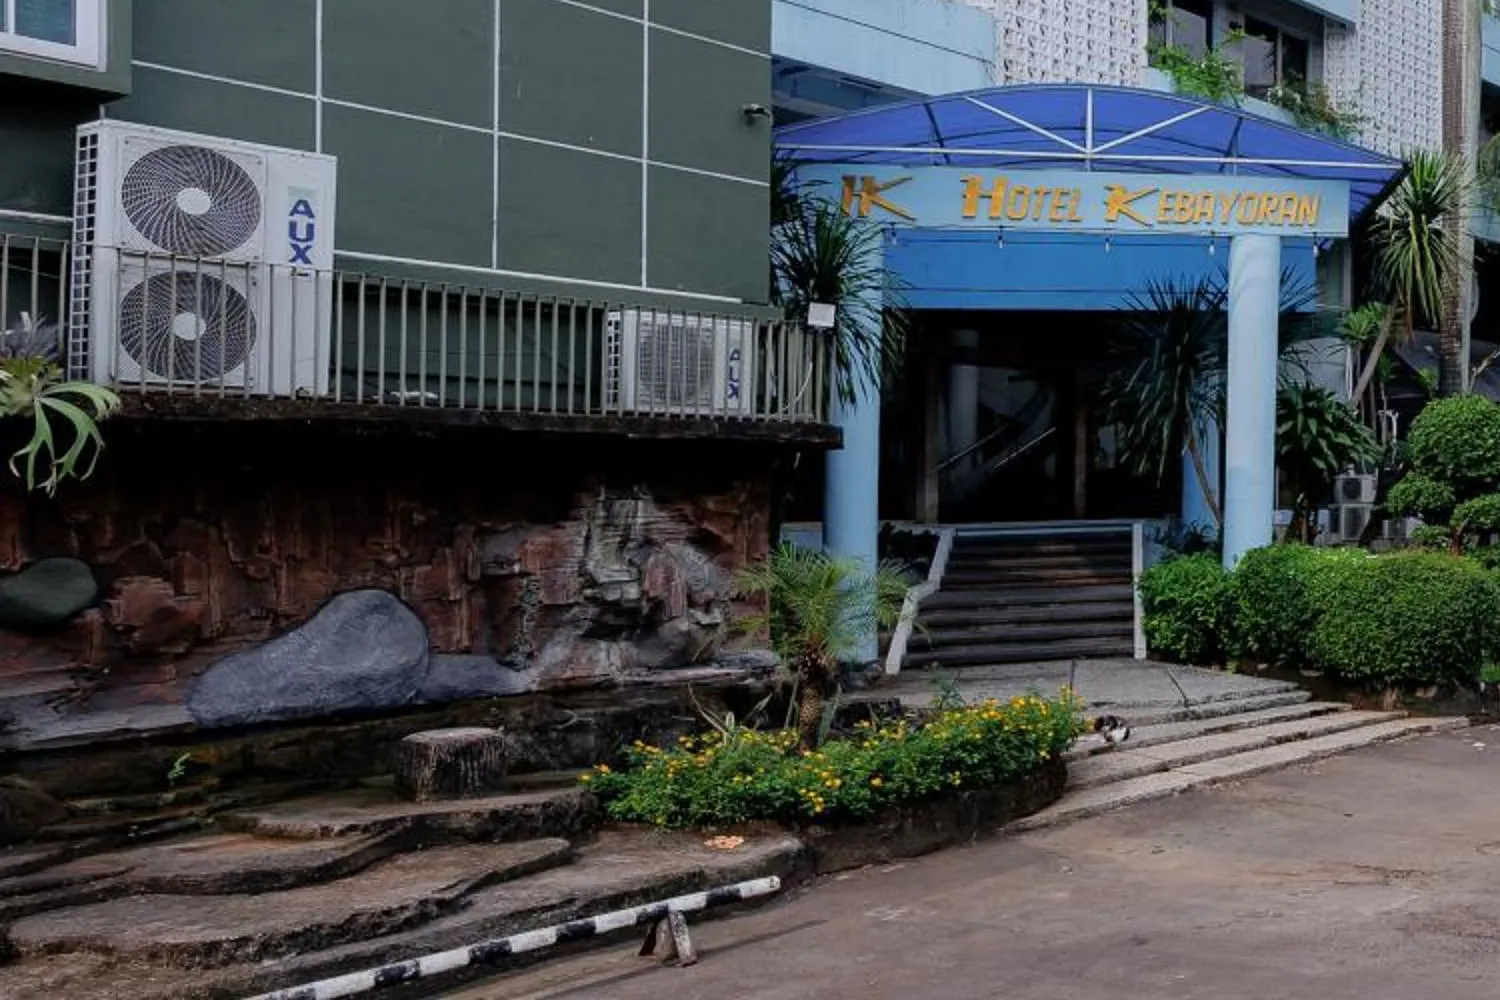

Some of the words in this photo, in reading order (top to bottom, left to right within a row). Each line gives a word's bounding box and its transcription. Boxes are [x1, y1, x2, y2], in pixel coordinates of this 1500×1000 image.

[960, 174, 1083, 222] HOTEL
[1103, 183, 1322, 228] KEBAYORAN
[288, 199, 315, 265] AUX
